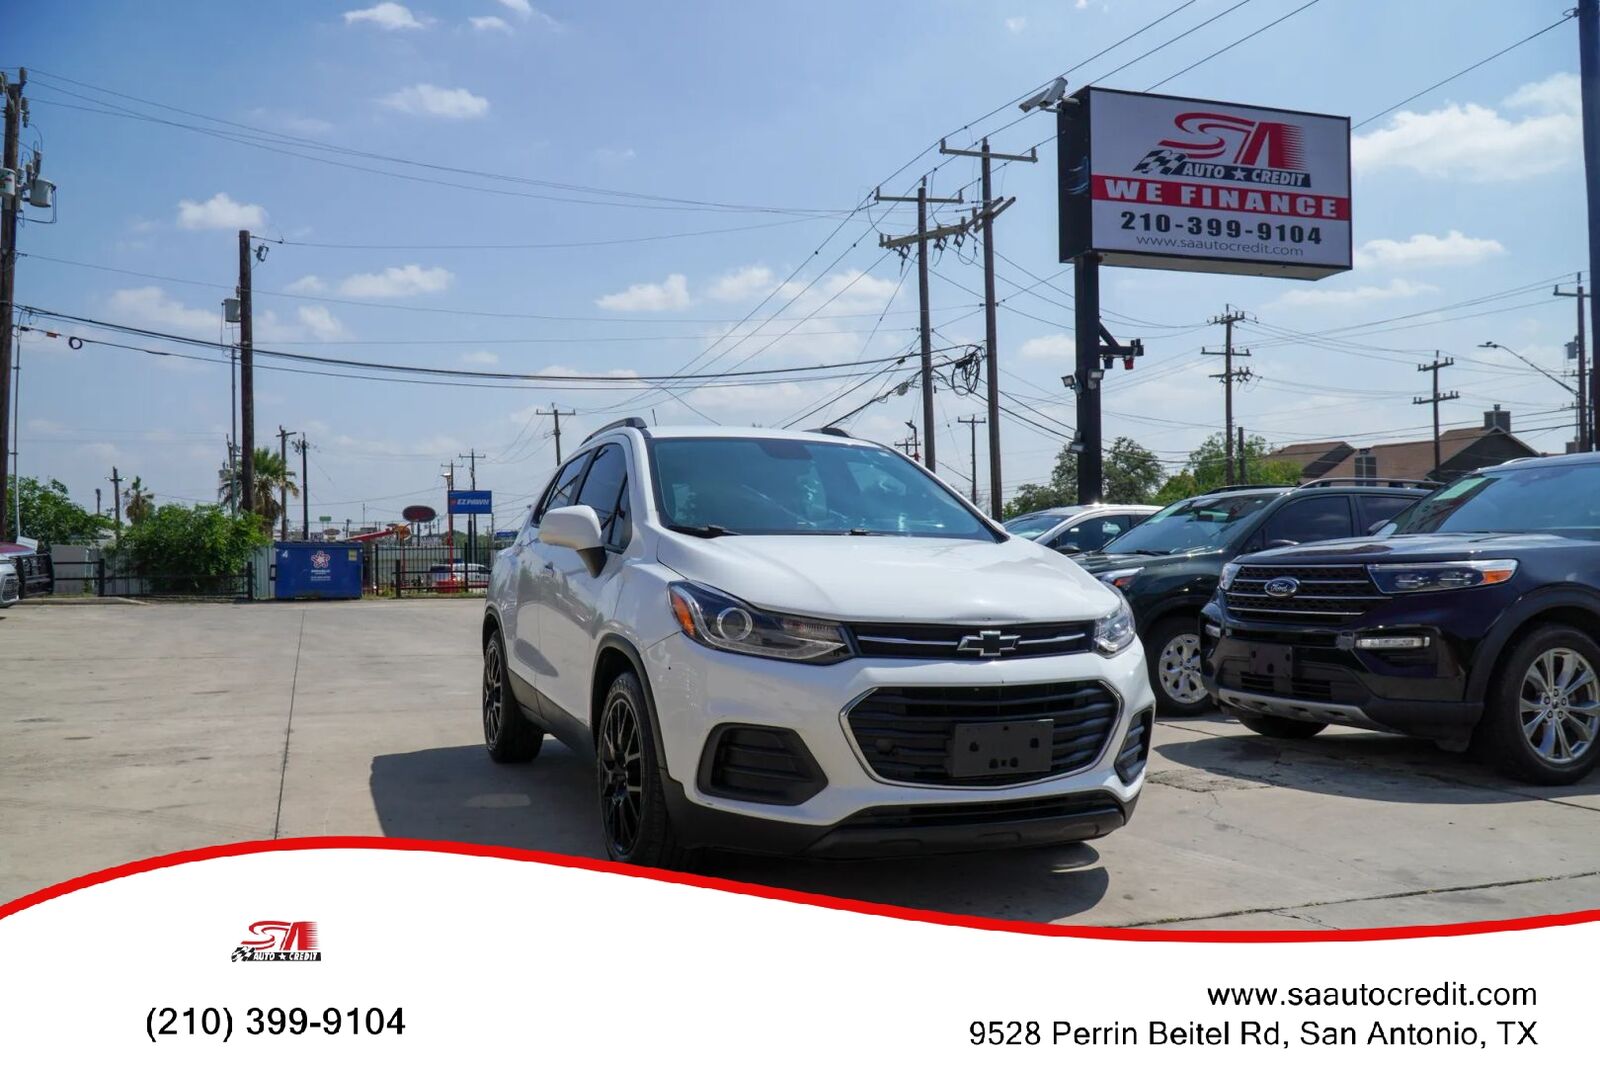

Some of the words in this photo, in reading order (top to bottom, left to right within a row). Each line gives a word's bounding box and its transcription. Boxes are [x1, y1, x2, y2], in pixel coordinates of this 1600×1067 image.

[1157, 111, 1306, 169] SA
[1181, 163, 1226, 179] AUTO
[1251, 169, 1307, 187] CREDIT
[1104, 178, 1163, 202] WE
[1180, 185, 1338, 218] FINANCE
[1120, 210, 1322, 245] 210-399-9104
[1135, 234, 1304, 257] www.saautocredit.com
